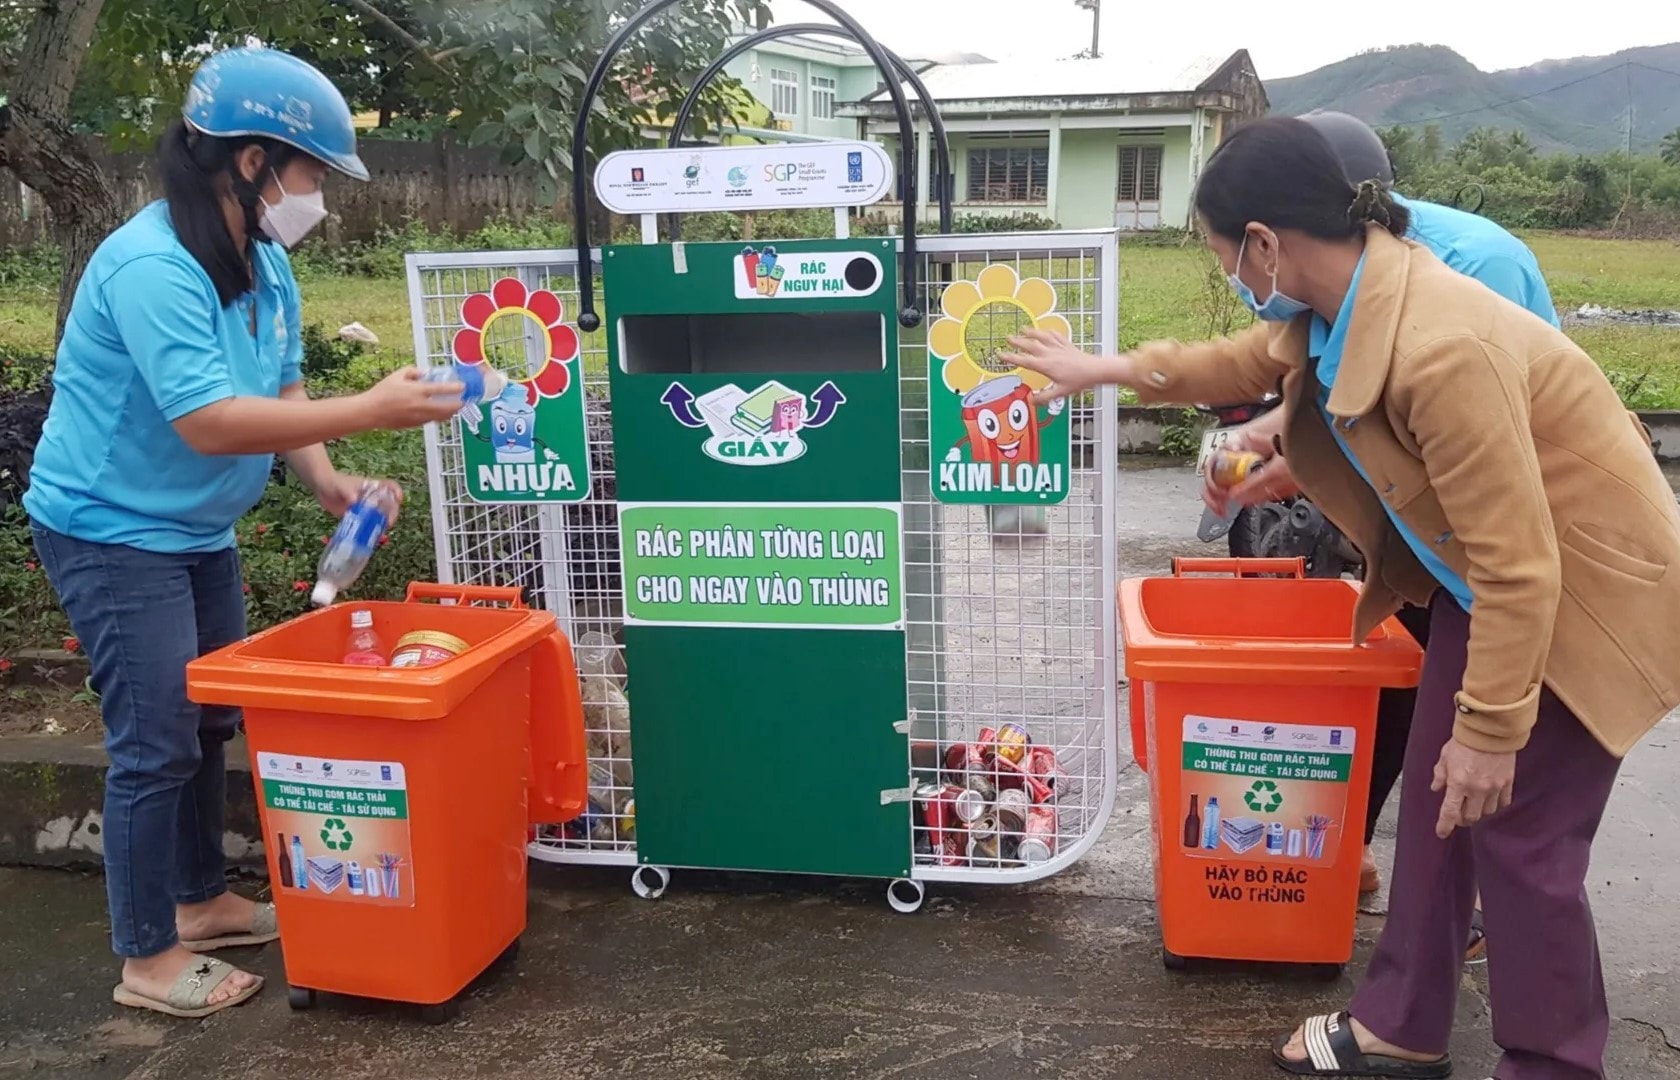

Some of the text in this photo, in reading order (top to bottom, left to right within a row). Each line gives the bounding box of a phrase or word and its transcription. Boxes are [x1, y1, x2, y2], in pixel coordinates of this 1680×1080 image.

[764, 163, 797, 183] SGP
[800, 260, 826, 275] RÁC
[783, 279, 844, 293] NGUY HẠI
[717, 435, 790, 457] GIẤY
[477, 461, 577, 498] NHỰA
[940, 463, 1062, 499] KIM LOẠI
[635, 524, 885, 565] RÁC PHÂN TỪNG LOẠI
[636, 571, 890, 607] CHO NGAY VÀO THÙNG
[1204, 747, 1330, 766] THÙNG THU GOM RÁC THẢI
[1194, 759, 1207, 770] CÓ
[1210, 758, 1227, 771] THỂ
[1230, 761, 1246, 773] TÁI
[1248, 762, 1267, 775] CHẾ
[1277, 764, 1292, 776] TÁI
[1294, 765, 1309, 778] SỬ
[1310, 769, 1338, 781] DỤNG
[278, 784, 387, 803] THÙNG THU GOM RÁC THẢI
[273, 796, 285, 807] CÓ
[286, 796, 301, 808] THỂ
[303, 799, 316, 811] TÁI
[317, 800, 335, 812] CHẾ
[341, 803, 356, 814] TÁI
[357, 803, 370, 815] SỬ
[371, 805, 397, 817] DỤNG
[1205, 864, 1308, 884] HÃY BỎ RÁC
[1208, 882, 1305, 903] VÀO THÙNG
